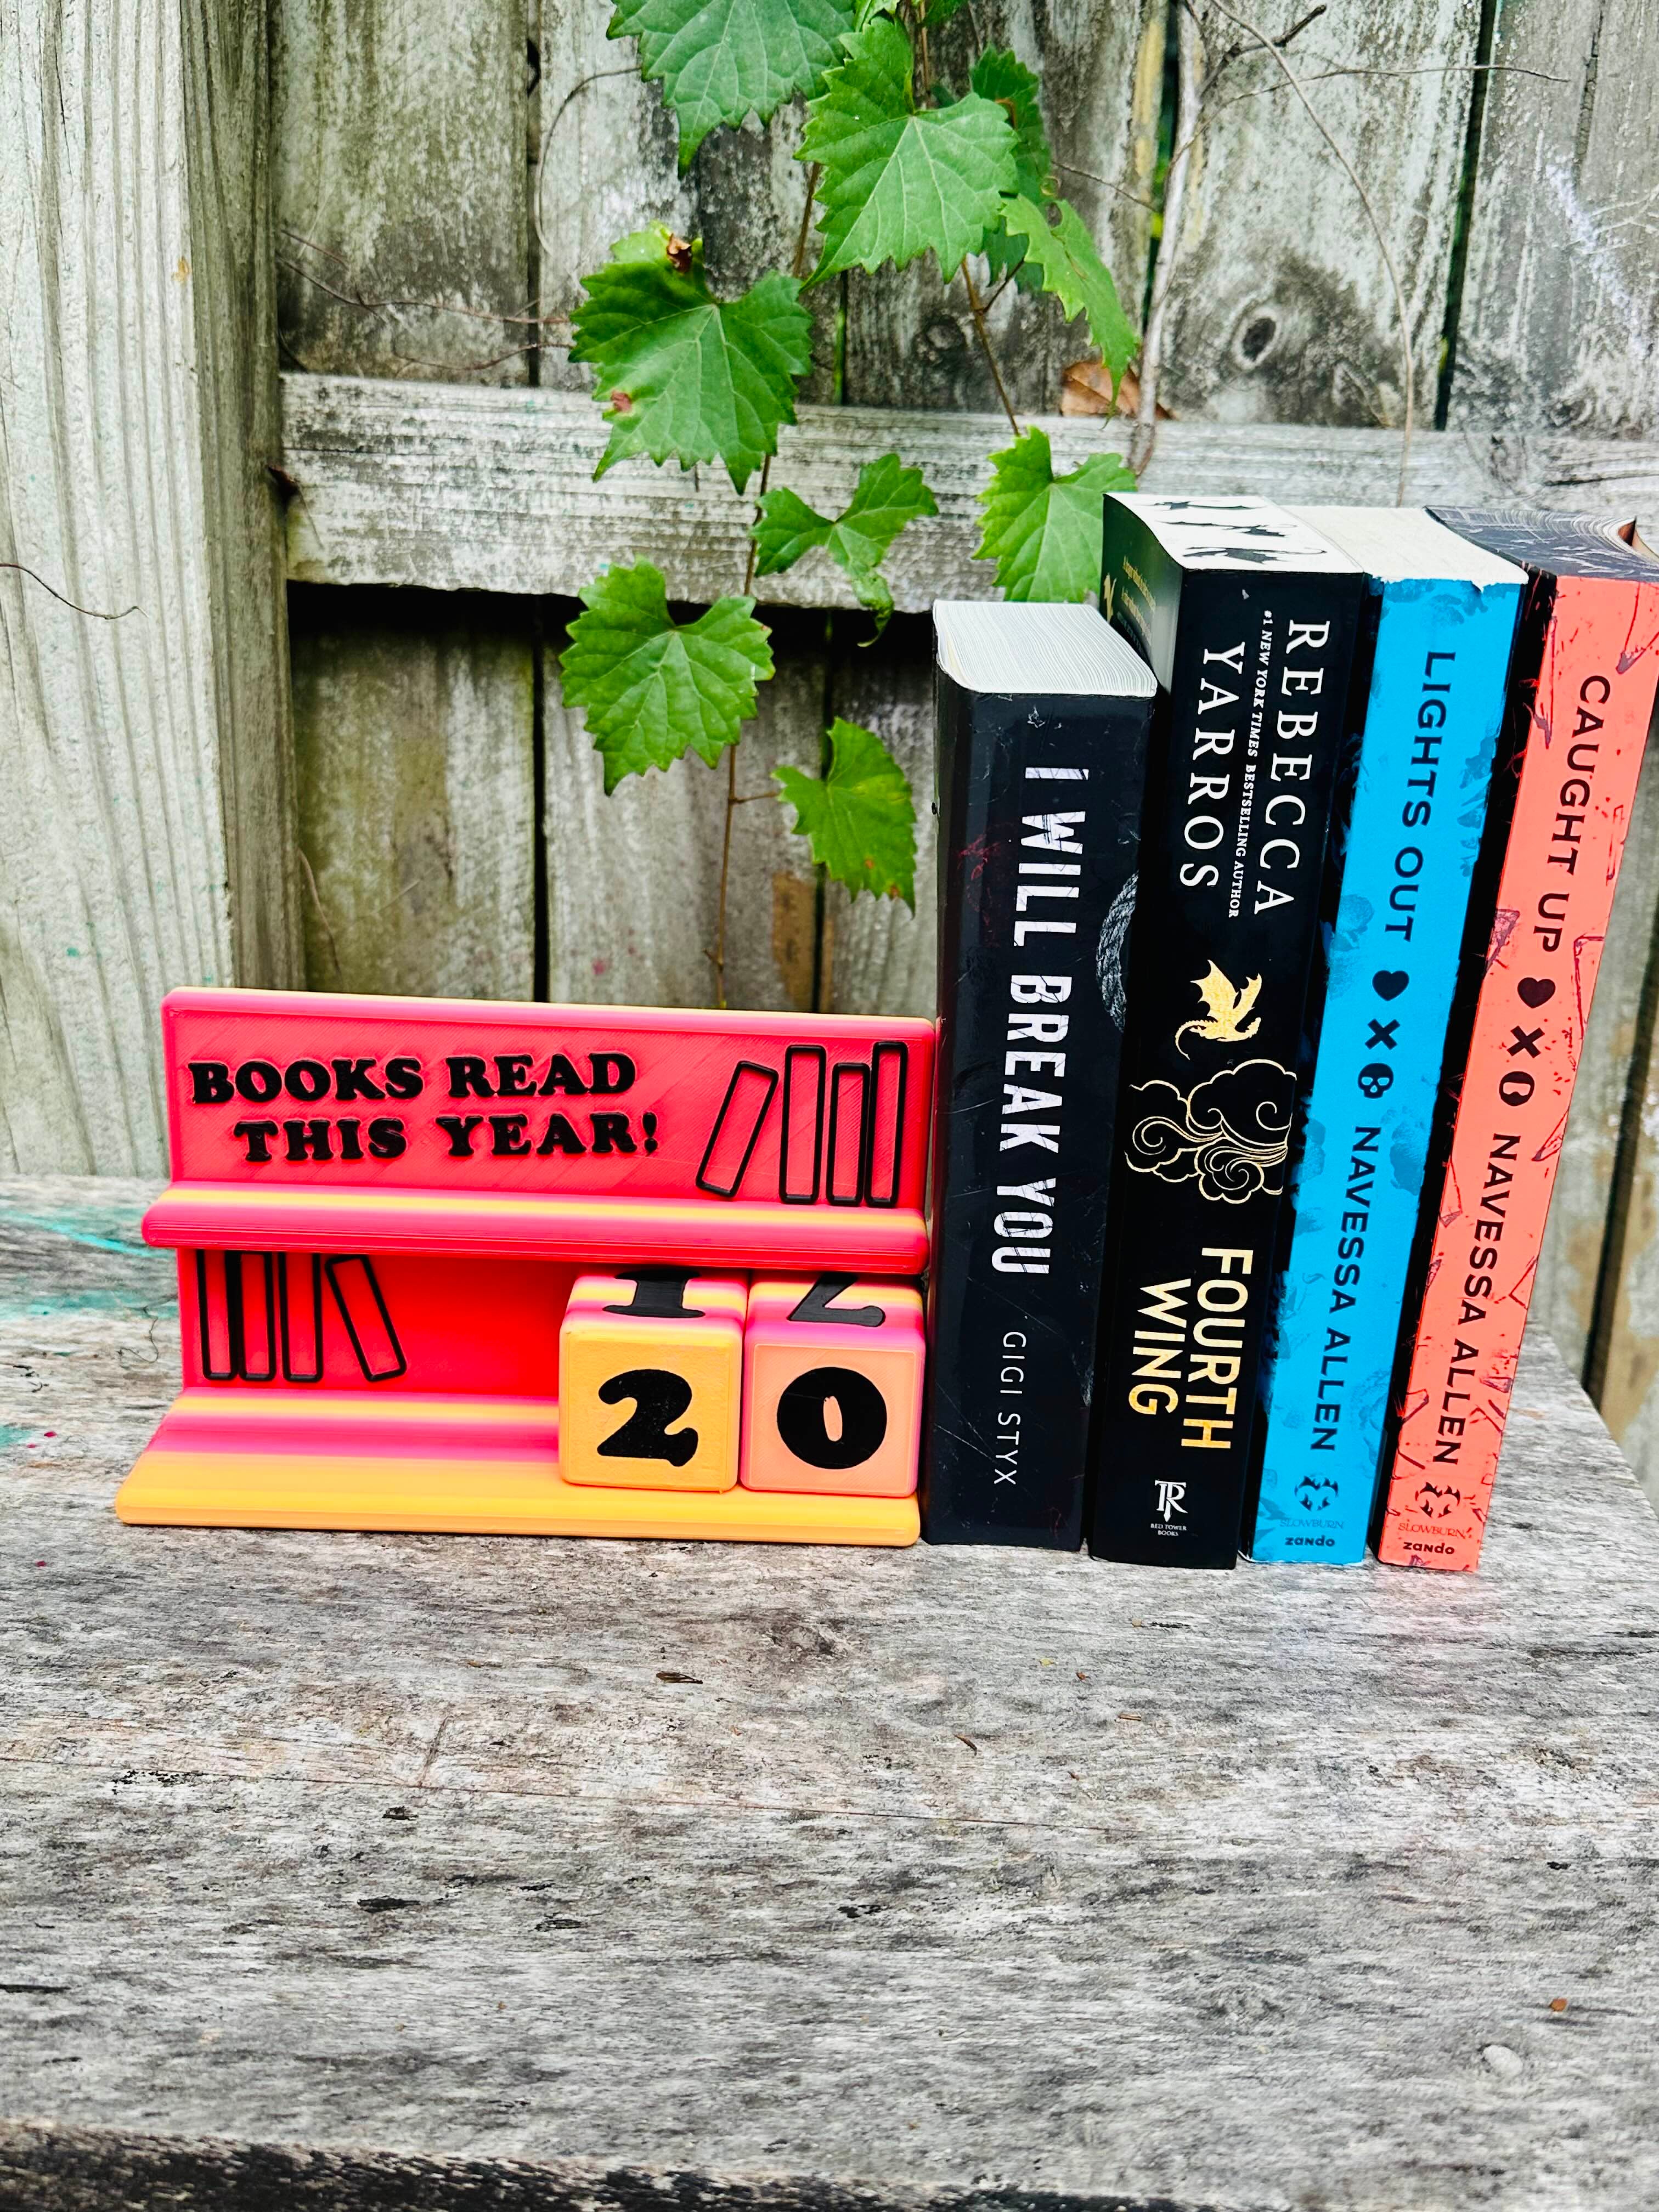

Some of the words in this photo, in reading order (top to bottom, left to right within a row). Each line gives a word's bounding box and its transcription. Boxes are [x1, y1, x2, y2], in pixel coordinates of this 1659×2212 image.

[1259, 630, 1273, 666] NEW
[1263, 610, 1273, 625] #1
[1248, 712, 1262, 757] TIMES
[1253, 669, 1268, 708] YORK
[1024, 766, 1090, 781] I
[1180, 641, 1245, 887] YARROS
[1254, 619, 1330, 915] REBECCA
[1402, 651, 1456, 827] LIGHTS
[1547, 675, 1611, 876] CAUGHT
[1235, 764, 1256, 857] BESTSELLING
[1014, 810, 1086, 947] WILL
[1228, 860, 1244, 918] AUTHOR
[1385, 846, 1424, 943] OUT
[1533, 893, 1570, 953] UP
[188, 1056, 424, 1104] BOOKS
[445, 1053, 636, 1098] READ
[999, 974, 1073, 1154] BREAK
[233, 1117, 407, 1162] THIS
[435, 1112, 658, 1157] YEAR!
[991, 1177, 1057, 1274] YOU
[1329, 1126, 1381, 1313] NAVESSA
[1458, 1132, 1522, 1326] NAVESSA
[999, 1331, 1027, 1395] GIGI
[1128, 1278, 1192, 1415] WING
[1181, 1248, 1254, 1449] FOURTH
[1311, 1327, 1351, 1451] ALLEN
[993, 1411, 1022, 1486] STYX
[1432, 1338, 1480, 1465] ALLEN
[1279, 1518, 1345, 1530] SLOWBURN
[1398, 1522, 1466, 1539] SLOWBURN
